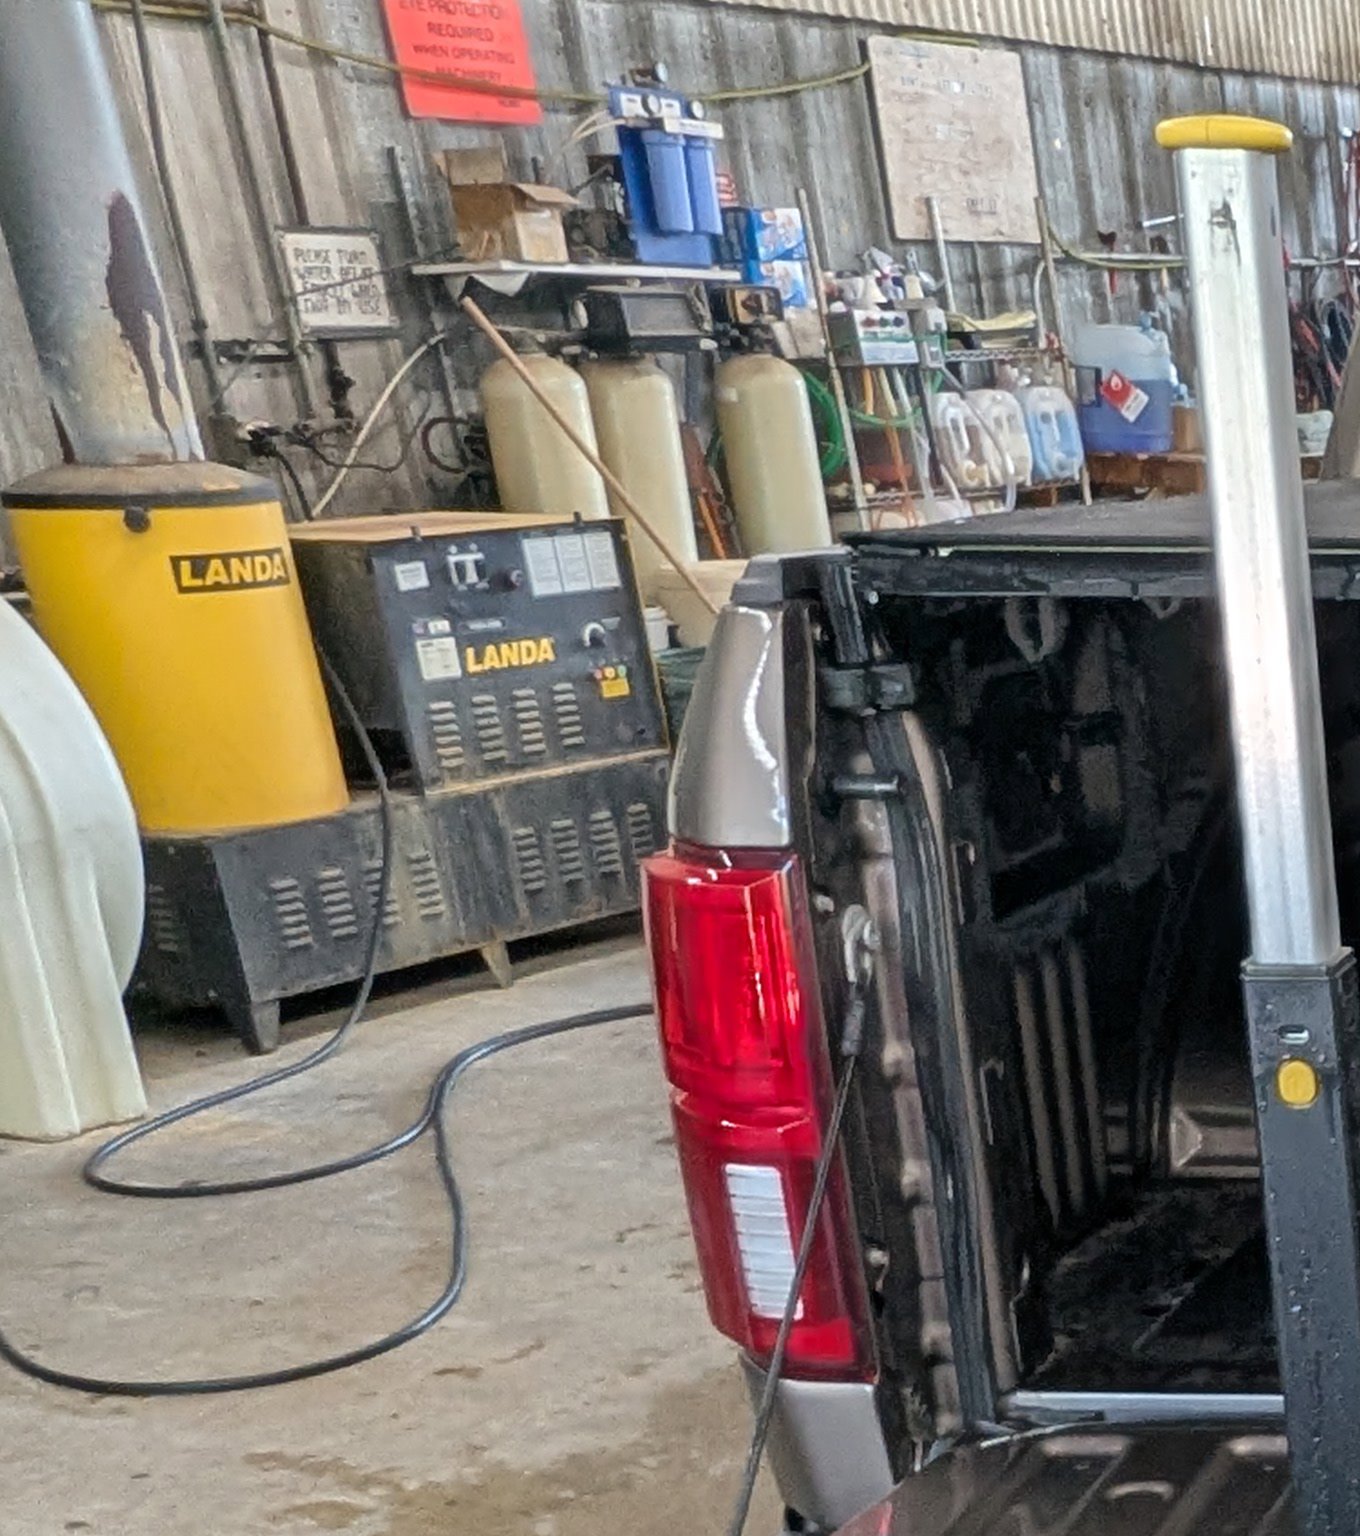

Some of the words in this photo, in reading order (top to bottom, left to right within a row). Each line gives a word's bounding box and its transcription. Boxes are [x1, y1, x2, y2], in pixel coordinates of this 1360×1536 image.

[426, 21, 494, 41] REQUIRED
[412, 44, 449, 58] WHEN
[451, 48, 515, 64] OPERATING
[180, 552, 286, 587] LANDA
[465, 637, 556, 674] LANDA
